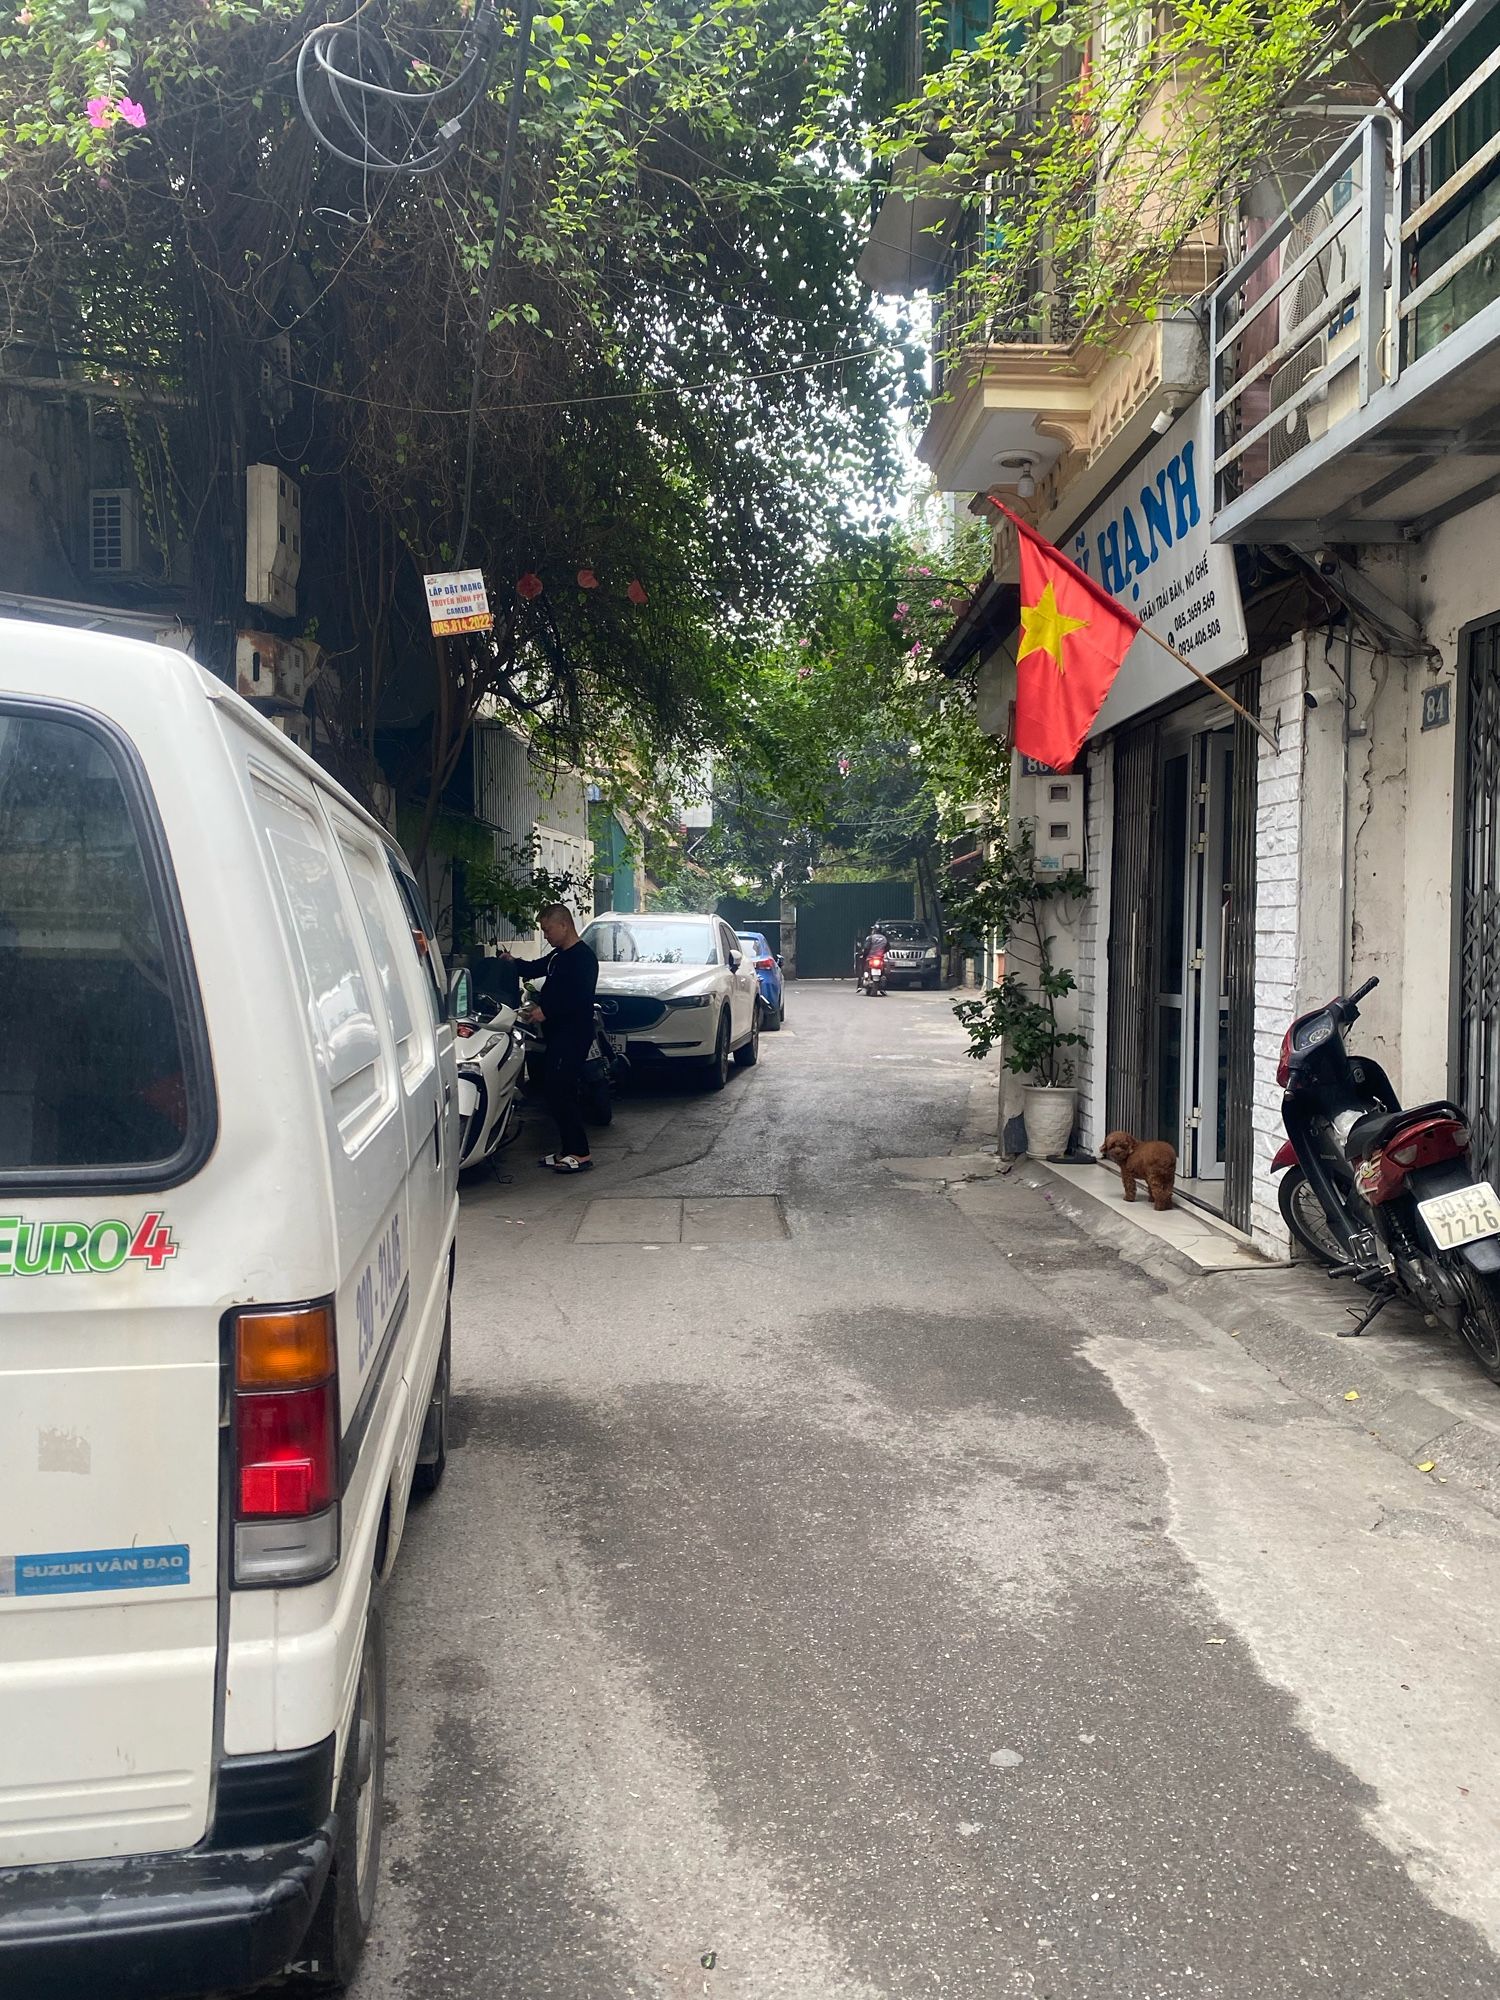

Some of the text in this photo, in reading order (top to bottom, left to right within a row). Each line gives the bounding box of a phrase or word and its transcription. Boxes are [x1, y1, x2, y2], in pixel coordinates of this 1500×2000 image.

[1097, 439, 1202, 602] HẠNH
[1195, 549, 1209, 581] GHẾ
[460, 582, 482, 593] MẠNG
[473, 593, 484, 602] FPT
[446, 605, 474, 615] CAMERA
[432, 613, 490, 635] 085.814.2022
[1178, 618, 1221, 657] 0934.406.508
[1426, 684, 1444, 722] 84
[1440, 1202, 1499, 1243] 7226
[22, 1555, 184, 1578] SUZUKI VÂN ĐẠO
